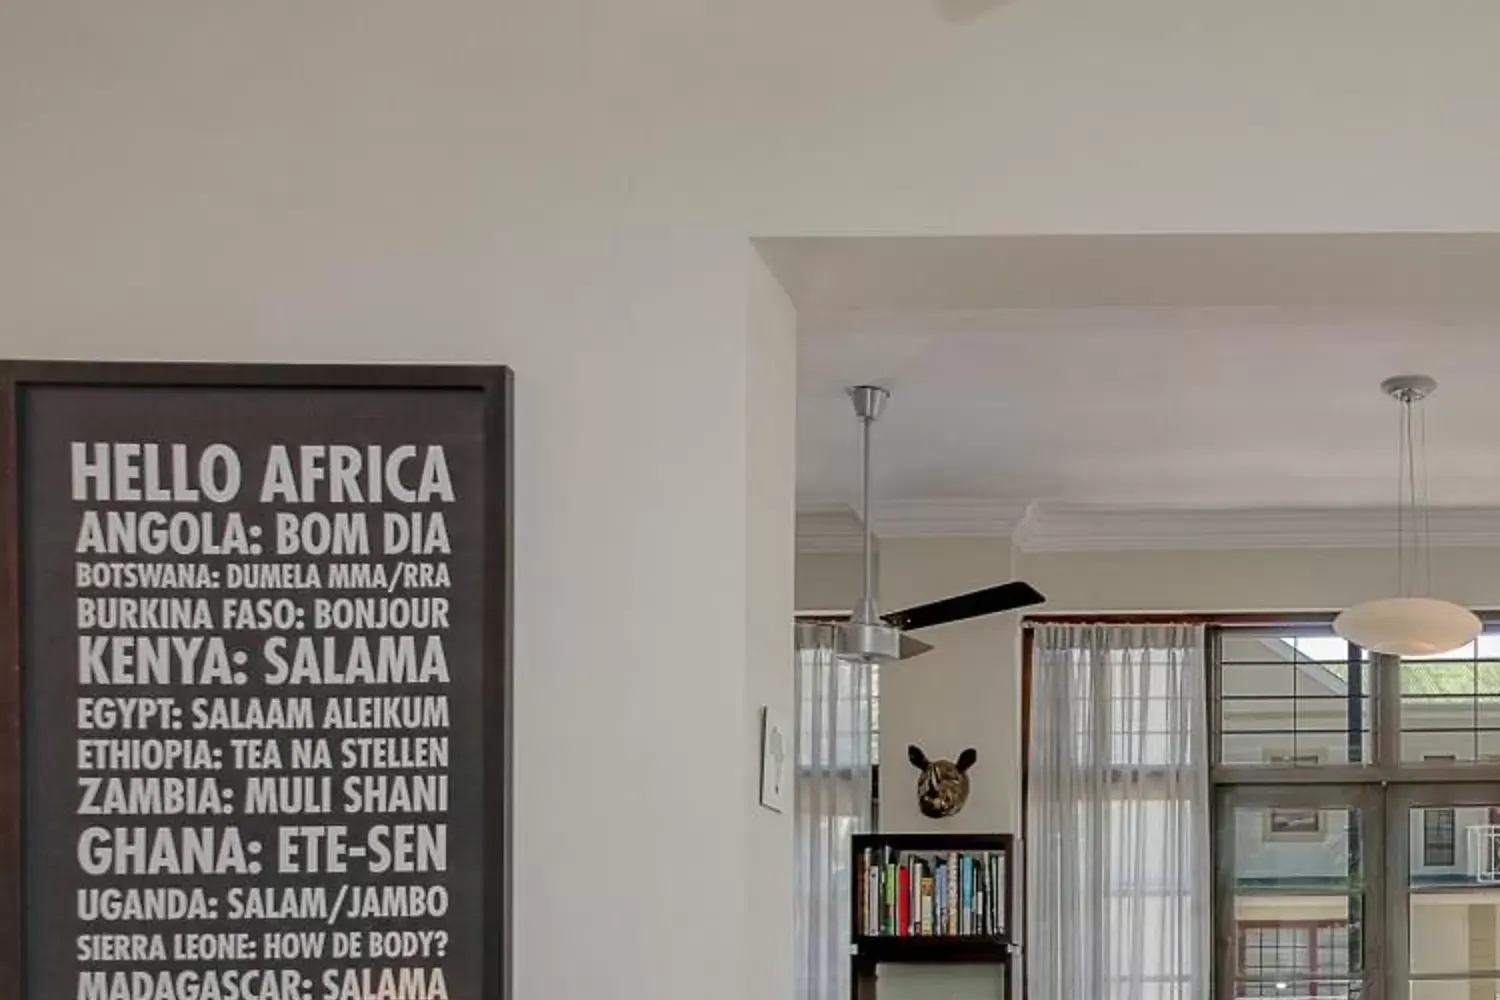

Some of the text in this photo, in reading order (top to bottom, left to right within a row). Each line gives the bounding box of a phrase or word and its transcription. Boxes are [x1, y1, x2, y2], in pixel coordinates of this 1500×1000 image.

[71, 441, 456, 503] HELLO AFRICA
[75, 510, 452, 556] ANGOLA: BOM DIA
[75, 561, 451, 593] BOTSWANA: DUMELA MMA/RRA
[76, 597, 450, 631] BURKINA FASO: BONJOUR
[78, 635, 451, 686] KENYA: SALAMA
[77, 695, 450, 730] EGYPT: SALAAM ALEIKUM
[77, 736, 449, 771] ETHIOPIA: TEA NA STELLEN
[76, 774, 449, 815] ZAMBIA: MULI SHANI
[77, 823, 447, 876] GHANA: ETE-SEN
[77, 884, 449, 925] UGANDA: SALAM/JAMBO
[76, 929, 449, 961] SIERRA LEONE: HOW DE BODY?
